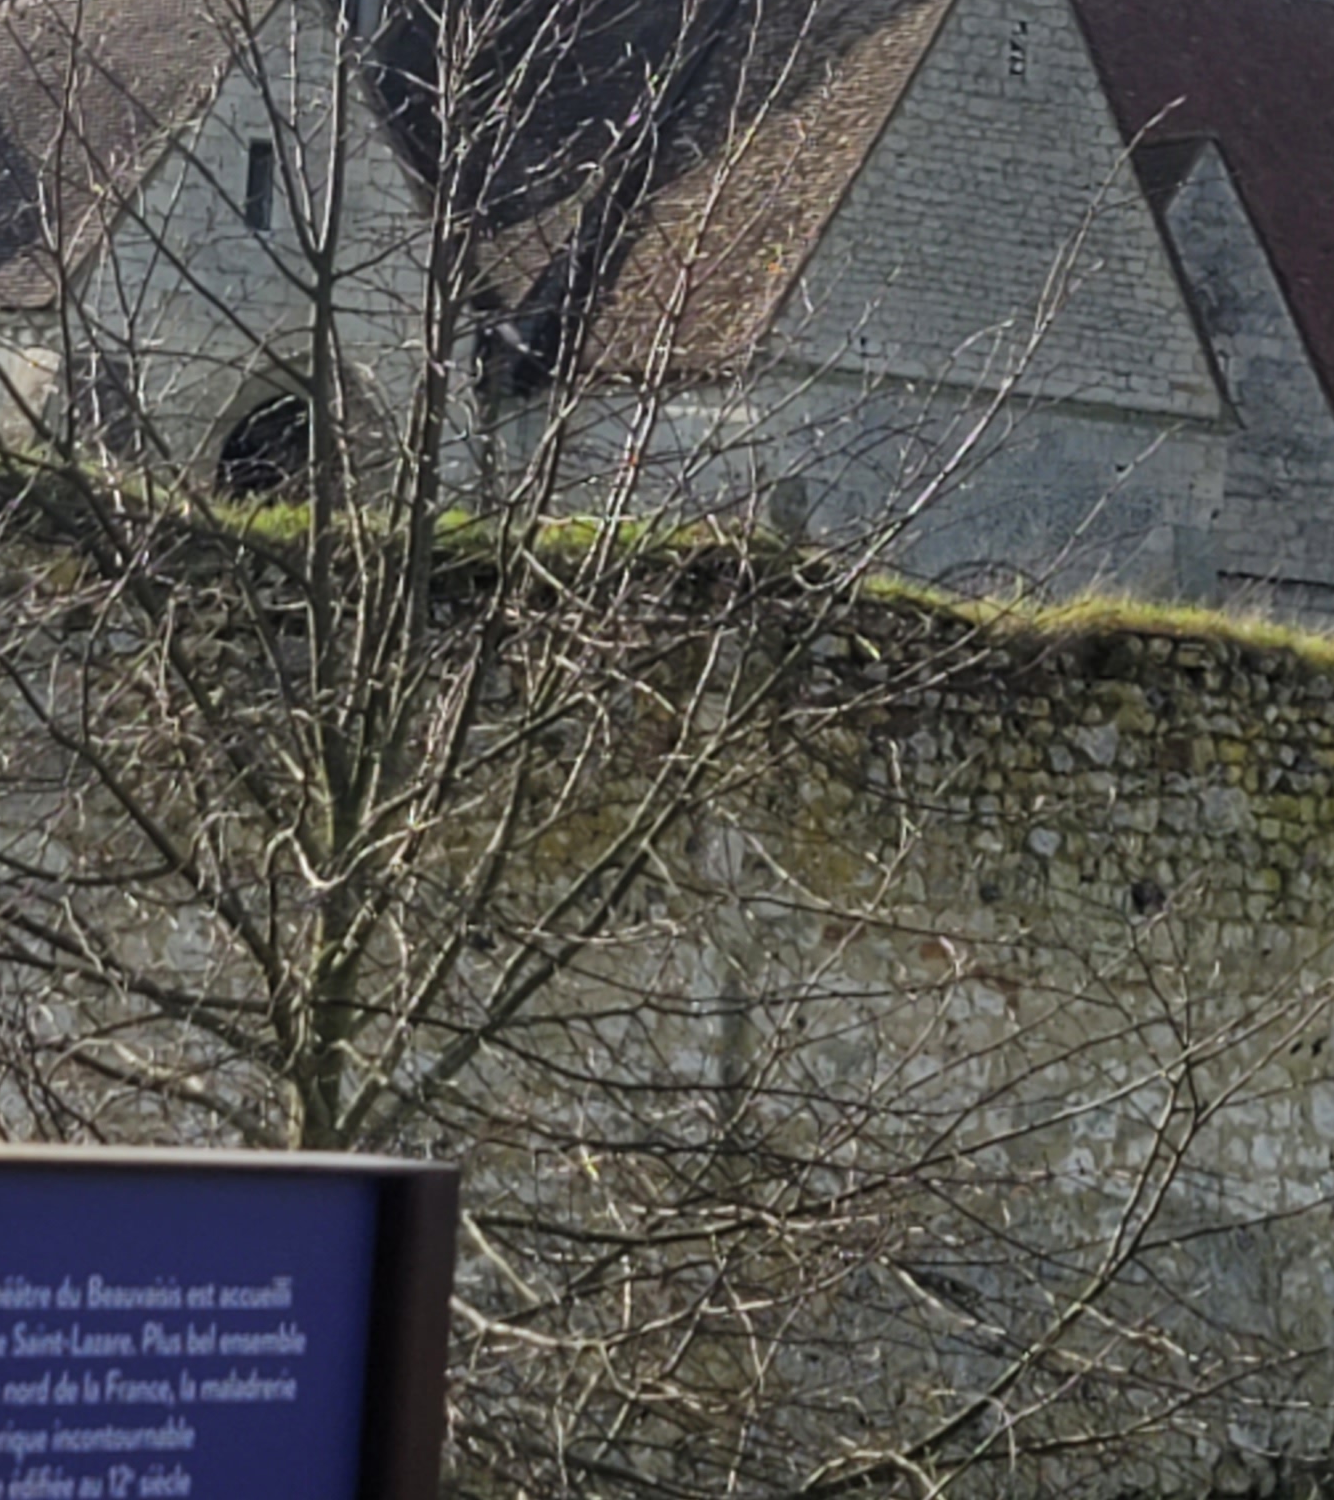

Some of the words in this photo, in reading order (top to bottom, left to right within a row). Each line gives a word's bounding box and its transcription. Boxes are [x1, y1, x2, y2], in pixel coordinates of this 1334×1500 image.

[56, 1274, 82, 1309] du
[88, 1274, 181, 1309] Beauvaisis
[186, 1282, 215, 1309] est
[219, 1275, 292, 1309] accueilli
[142, 1321, 181, 1355] Plus
[186, 1322, 217, 1355] bel
[219, 1322, 307, 1355] ensemble
[2, 1370, 51, 1405] nord
[53, 1370, 79, 1404] de
[83, 1370, 101, 1404] la
[104, 1367, 175, 1409] France,
[179, 1368, 197, 1401] la
[200, 1367, 297, 1401] maladrerie
[51, 1415, 196, 1451] incontournable
[78, 1476, 103, 1499] au
